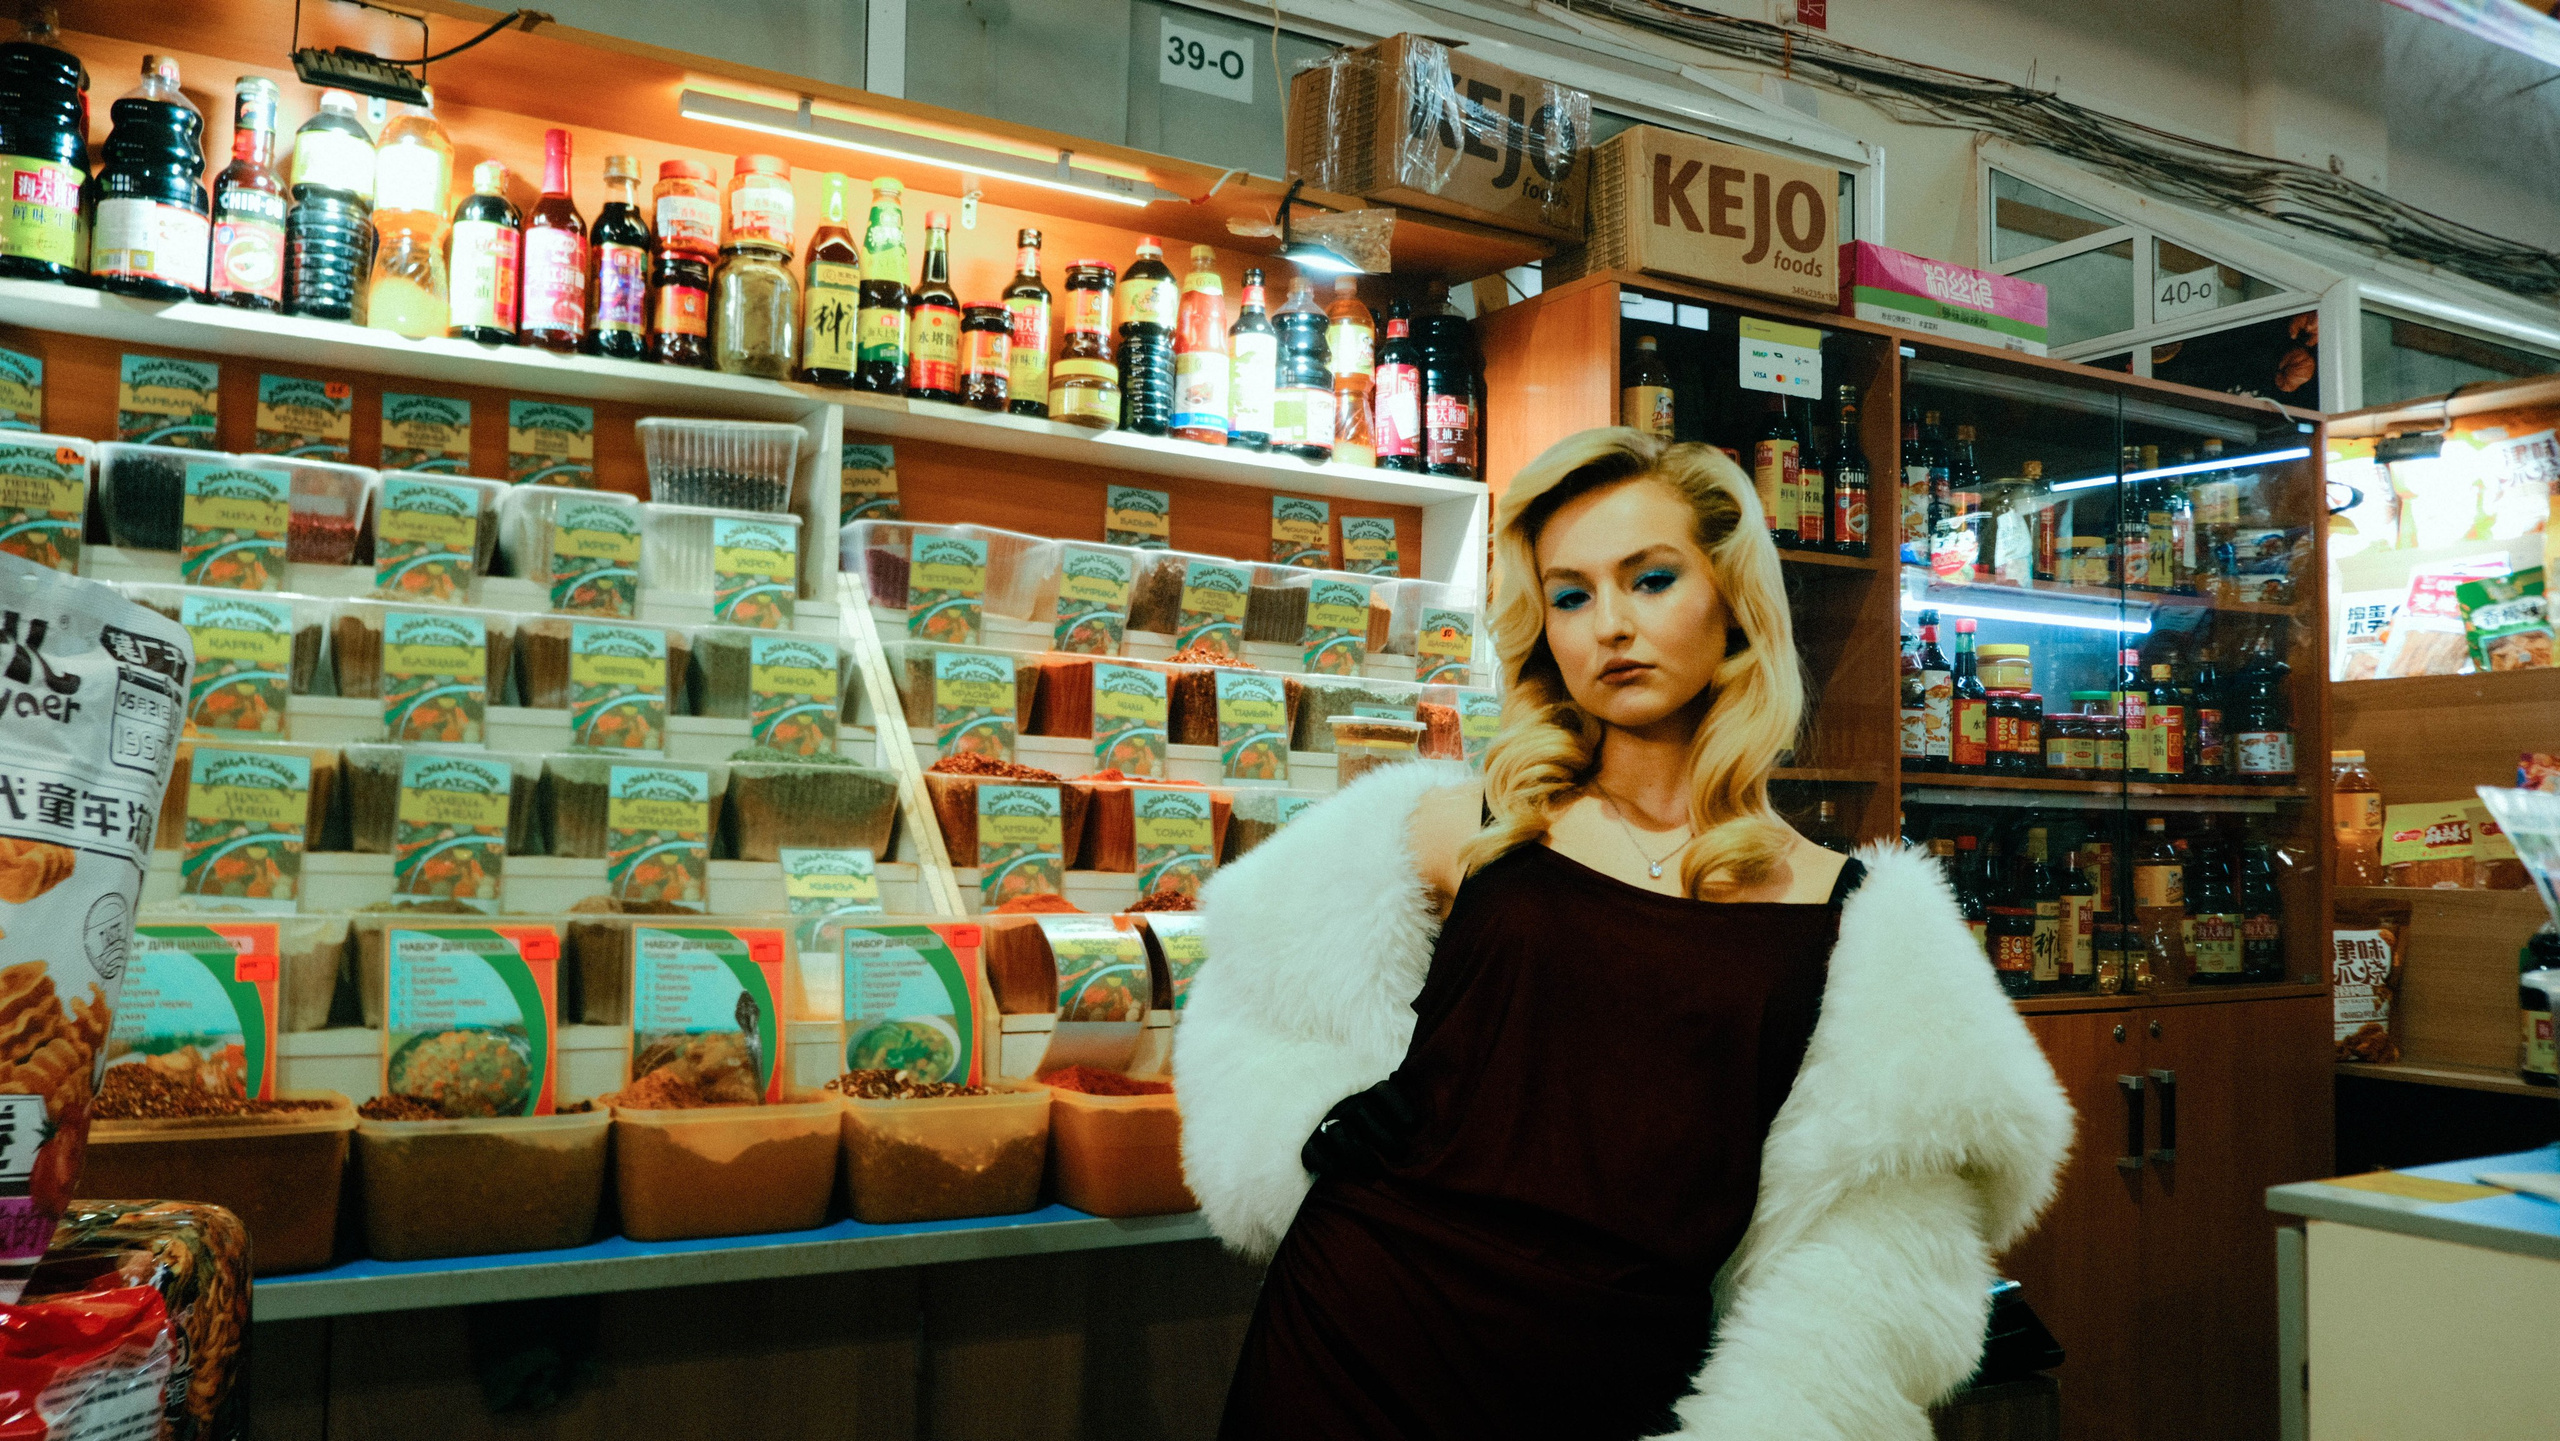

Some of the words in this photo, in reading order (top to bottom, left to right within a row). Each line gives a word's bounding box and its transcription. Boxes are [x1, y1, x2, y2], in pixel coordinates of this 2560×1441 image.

[1522, 177, 1570, 207] foods
[1653, 153, 1827, 264] KEJO
[1773, 251, 1823, 278] foods
[1753, 370, 1767, 379] VISA
[1153, 828, 1195, 838] ТОМАТ
